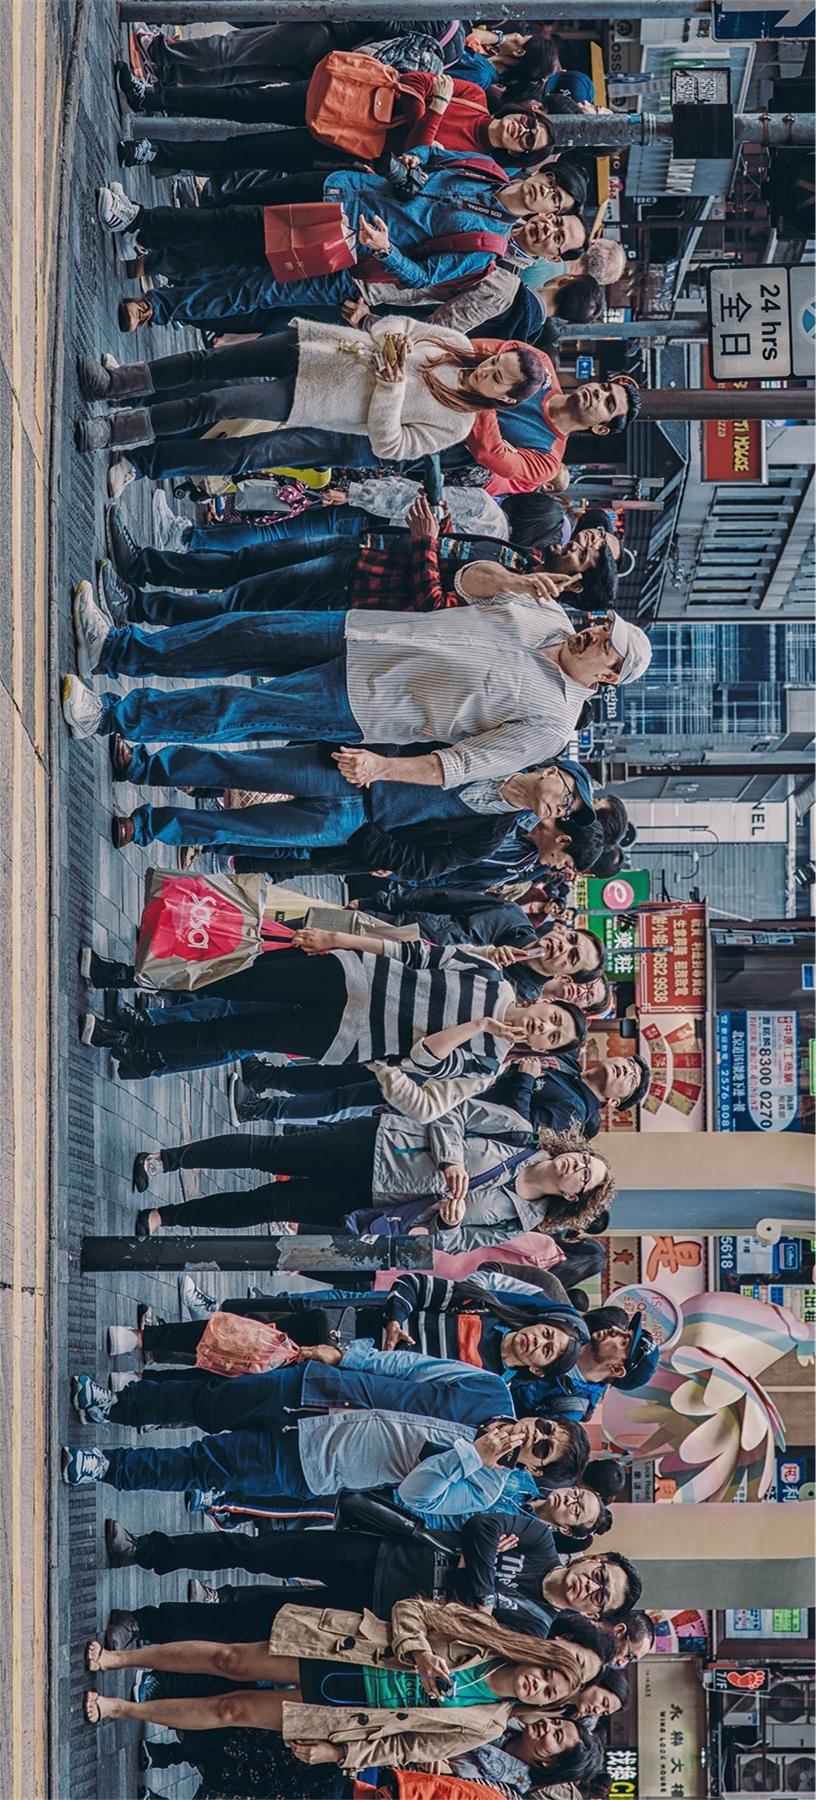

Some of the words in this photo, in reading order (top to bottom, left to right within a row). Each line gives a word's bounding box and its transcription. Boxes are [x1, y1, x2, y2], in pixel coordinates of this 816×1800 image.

[760, 284, 782, 313] 24
[720, 292, 752, 357] 全日
[761, 321, 782, 361] hrs
[733, 436, 750, 472] HOUSE
[604, 684, 618, 719] egna
[653, 977, 668, 1003] 9938
[759, 1048, 772, 1086] 8300
[720, 1070, 730, 1100] 2576
[759, 1091, 772, 1129] 0270
[716, 1672, 727, 1690] 7/F
[606, 1750, 637, 1780] 找換
